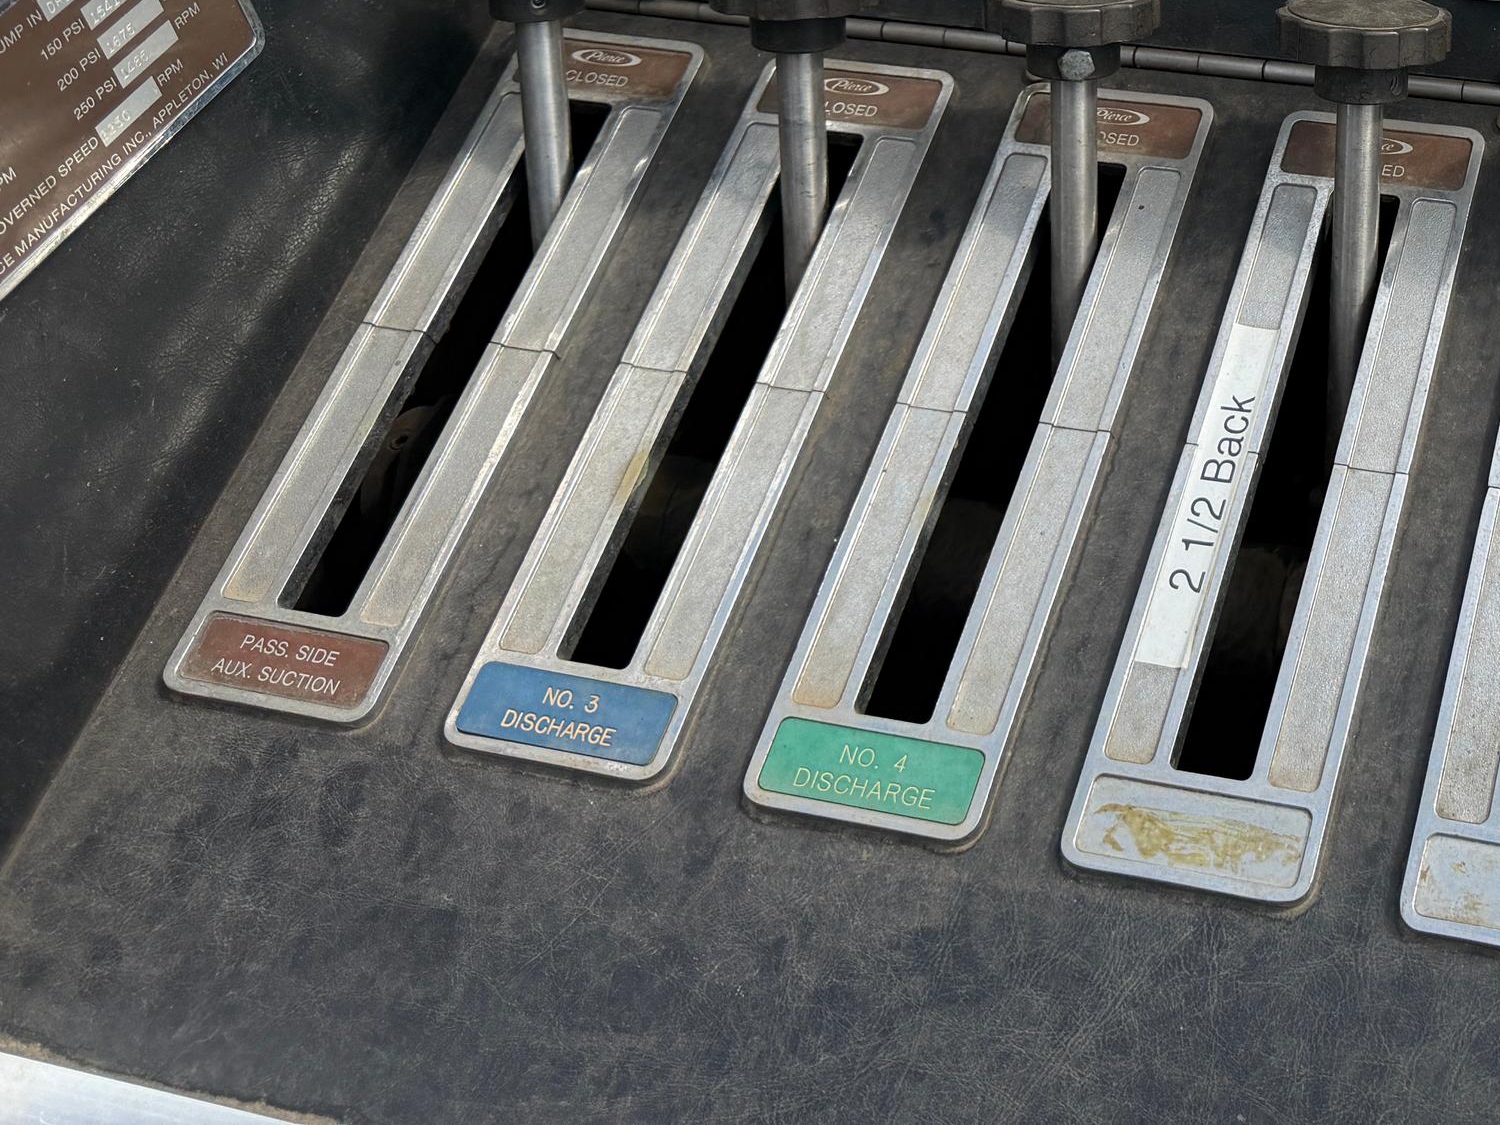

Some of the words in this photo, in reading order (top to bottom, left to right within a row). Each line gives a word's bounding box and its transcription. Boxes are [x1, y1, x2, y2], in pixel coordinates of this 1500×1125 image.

[0, 25, 24, 54] UMP
[26, 10, 43, 29] IN
[40, 38, 63, 61] 150
[63, 18, 85, 44] PSI
[56, 68, 79, 92] 200
[79, 47, 102, 73] PSI
[73, 97, 96, 121] 250
[96, 76, 118, 102] PSI
[174, 2, 202, 31] RPM
[566, 69, 629, 88] CLOSED
[0, 175, 57, 235] OVERNED
[58, 136, 99, 178] SPEED
[156, 58, 185, 88] RPM
[14, 153, 122, 257] MANUFACTURING
[123, 129, 152, 156] INC.,
[152, 69, 214, 129] APPLETON,
[212, 52, 229, 70] WI
[1200, 395, 1256, 484] Back
[1181, 496, 1227, 551] 1/2
[1169, 568, 1206, 594] 2
[240, 633, 290, 657] PASS.
[294, 642, 341, 668] SIDE
[210, 656, 252, 679] AUX.
[256, 665, 341, 697] SUCTION
[542, 686, 575, 710] NO.
[584, 694, 599, 713] 3
[500, 709, 617, 748] DISCHARGE
[838, 743, 881, 772] NO.
[893, 753, 909, 775] 4
[793, 766, 936, 812] DISCHARGE
